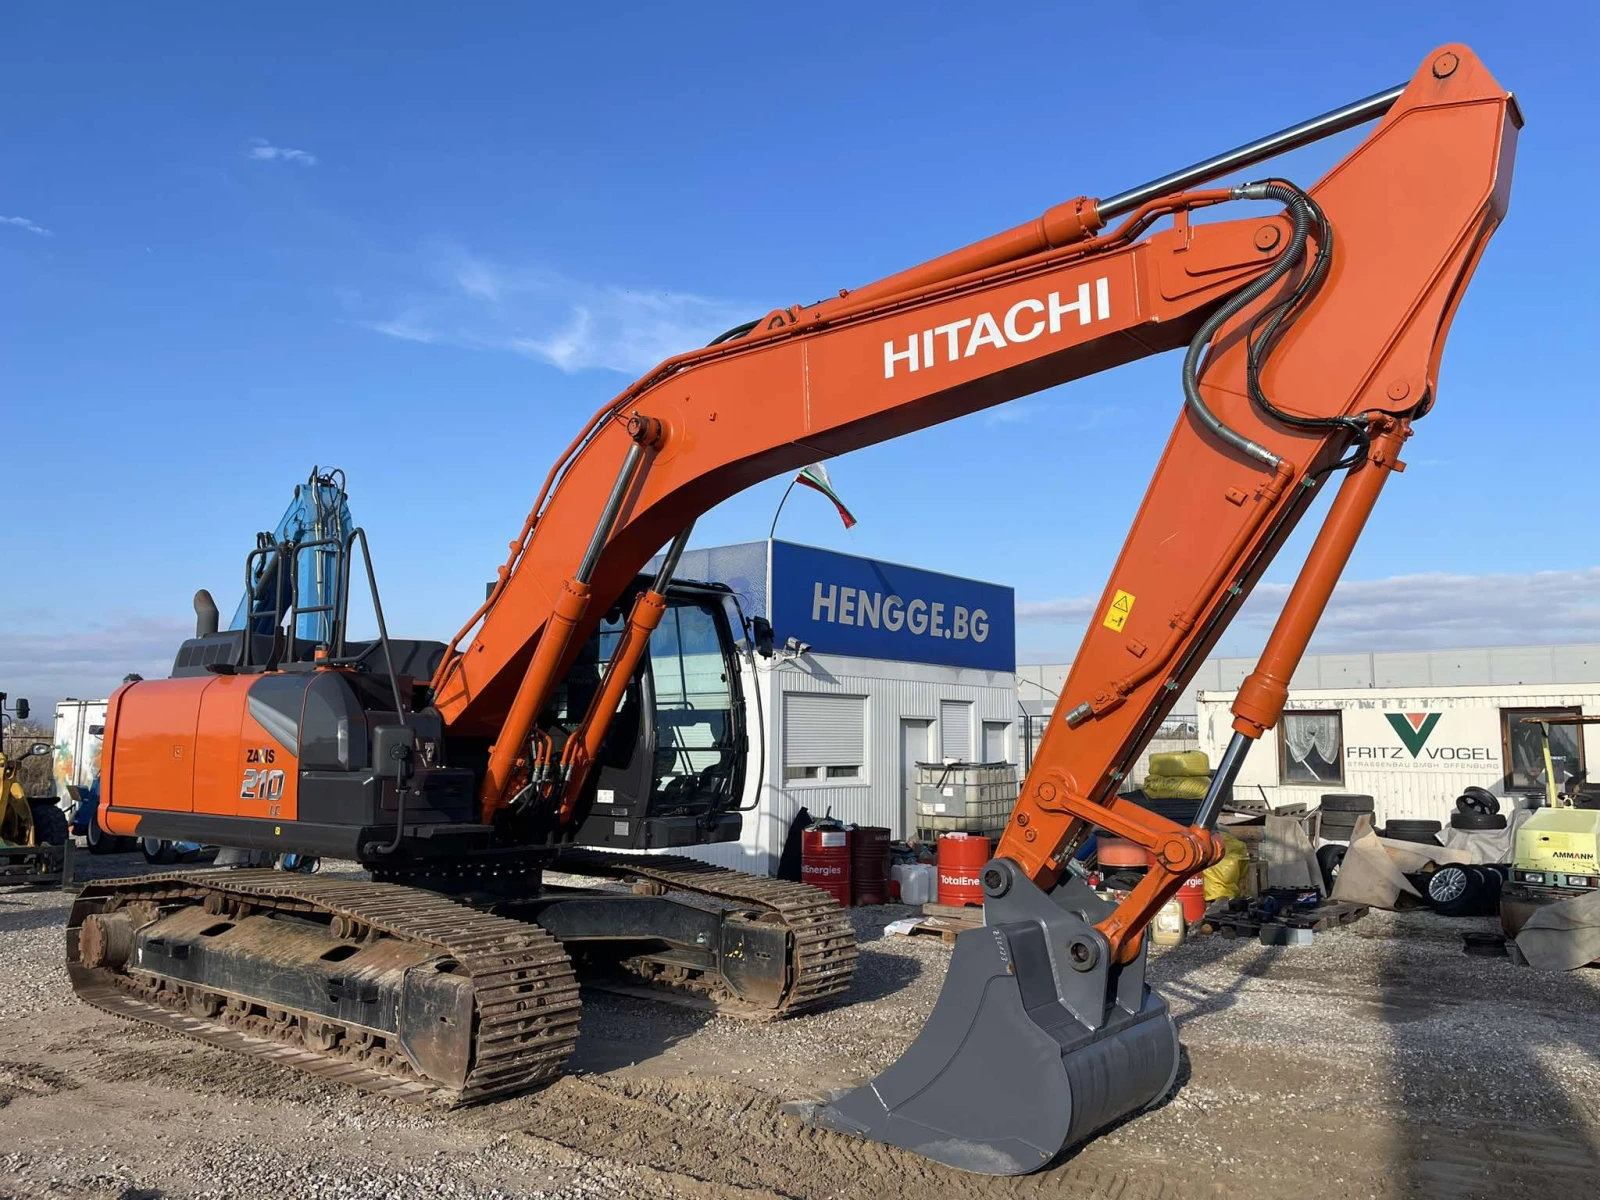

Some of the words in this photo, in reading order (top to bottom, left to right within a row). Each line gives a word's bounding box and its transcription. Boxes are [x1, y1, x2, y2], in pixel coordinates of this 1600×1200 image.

[884, 277, 1110, 379] HITACHI
[812, 582, 989, 643] HENGGE.BG
[1346, 746, 1404, 759] FRITZ
[1425, 747, 1498, 760] VOGEL
[240, 768, 285, 801] 210
[1552, 851, 1594, 860] AMMANN
